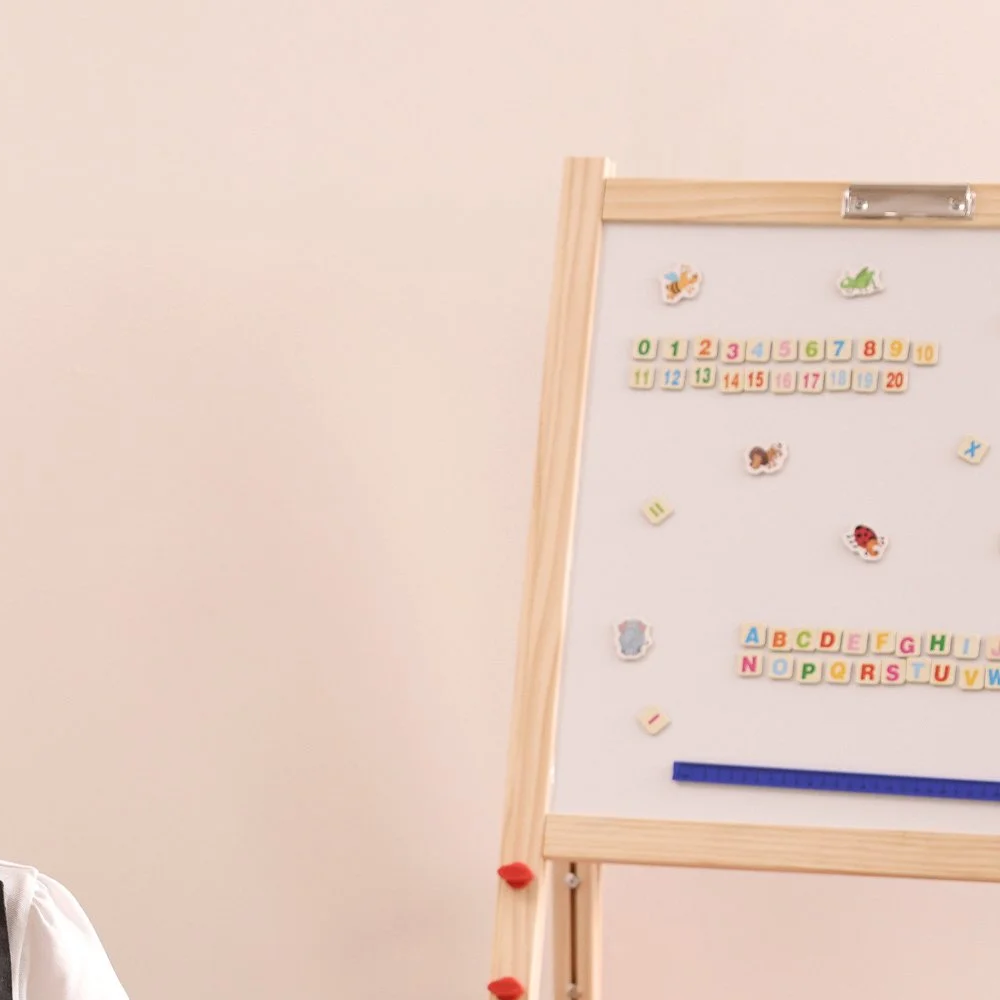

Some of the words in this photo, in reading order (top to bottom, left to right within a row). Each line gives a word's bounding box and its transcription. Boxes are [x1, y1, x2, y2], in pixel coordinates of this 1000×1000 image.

[638, 338, 650, 356] 0
[671, 340, 679, 357] 1
[698, 338, 712, 356] 2
[727, 342, 739, 360] 3
[751, 341, 764, 358] 4
[778, 339, 791, 358] 5
[805, 339, 818, 358] 6
[833, 339, 845, 357] 7
[863, 339, 876, 357] 8
[889, 339, 903, 358] 9
[915, 345, 934, 362] 10
[634, 368, 650, 385] 11
[664, 368, 681, 386] 12
[695, 367, 711, 384] 13
[723, 371, 739, 389] 14
[748, 370, 764, 388] 15
[776, 371, 791, 389] 16
[802, 371, 820, 389] 17
[830, 369, 846, 386] 18
[857, 370, 873, 389] 19
[886, 371, 904, 389] 20
[744, 626, 759, 644] A
[772, 631, 787, 648] B
[796, 631, 811, 648] C
[820, 630, 836, 648] D
[847, 633, 861, 651] E
[876, 633, 889, 651] F
[900, 636, 915, 654] G
[929, 634, 946, 652] H
[741, 655, 757, 673] N
[772, 658, 788, 676] O
[801, 663, 816, 680] P
[830, 661, 846, 681] Q
[860, 663, 876, 680] R
[886, 664, 900, 682] S
[911, 662, 925, 679] T
[934, 664, 951, 682] U
[964, 668, 979, 687] V
